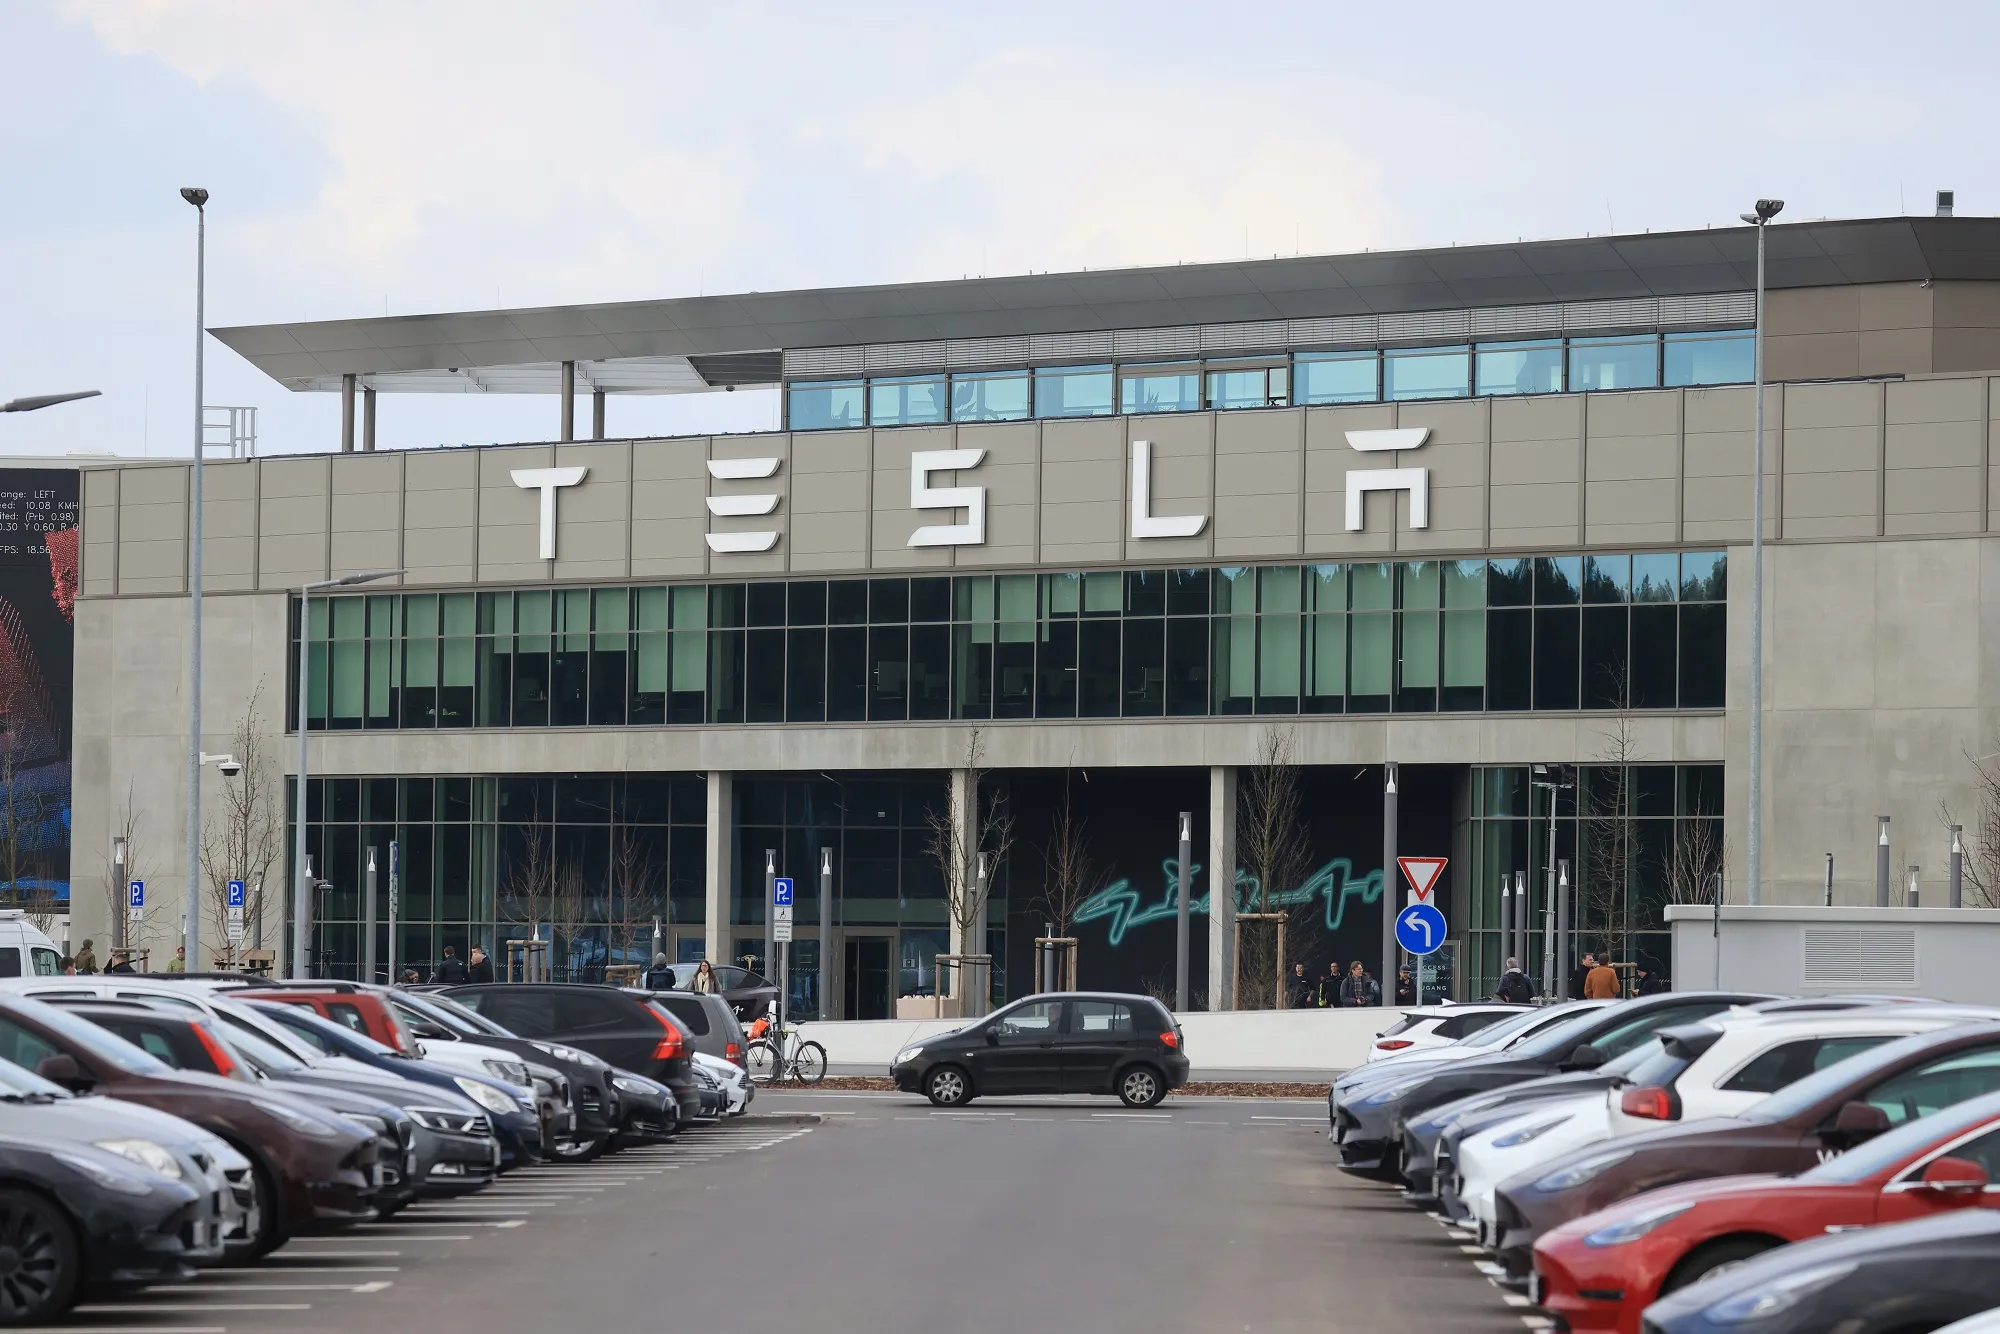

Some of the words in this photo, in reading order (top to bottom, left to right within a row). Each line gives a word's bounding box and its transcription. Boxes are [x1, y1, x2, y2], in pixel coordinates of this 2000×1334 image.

[34, 490, 56, 499] LEFT
[509, 426, 1431, 561] TESLA
[25, 501, 51, 510] 10.08
[58, 501, 79, 510] KMH
[25, 512, 45, 522] (Prb
[51, 511, 75, 522] 0.98)
[24, 522, 30, 531] Y
[33, 522, 55, 531] 0.60
[60, 522, 67, 531] R
[26, 545, 51, 554] 18.56
[132, 884, 140, 903] P
[230, 883, 239, 903] P
[777, 882, 788, 902] P
